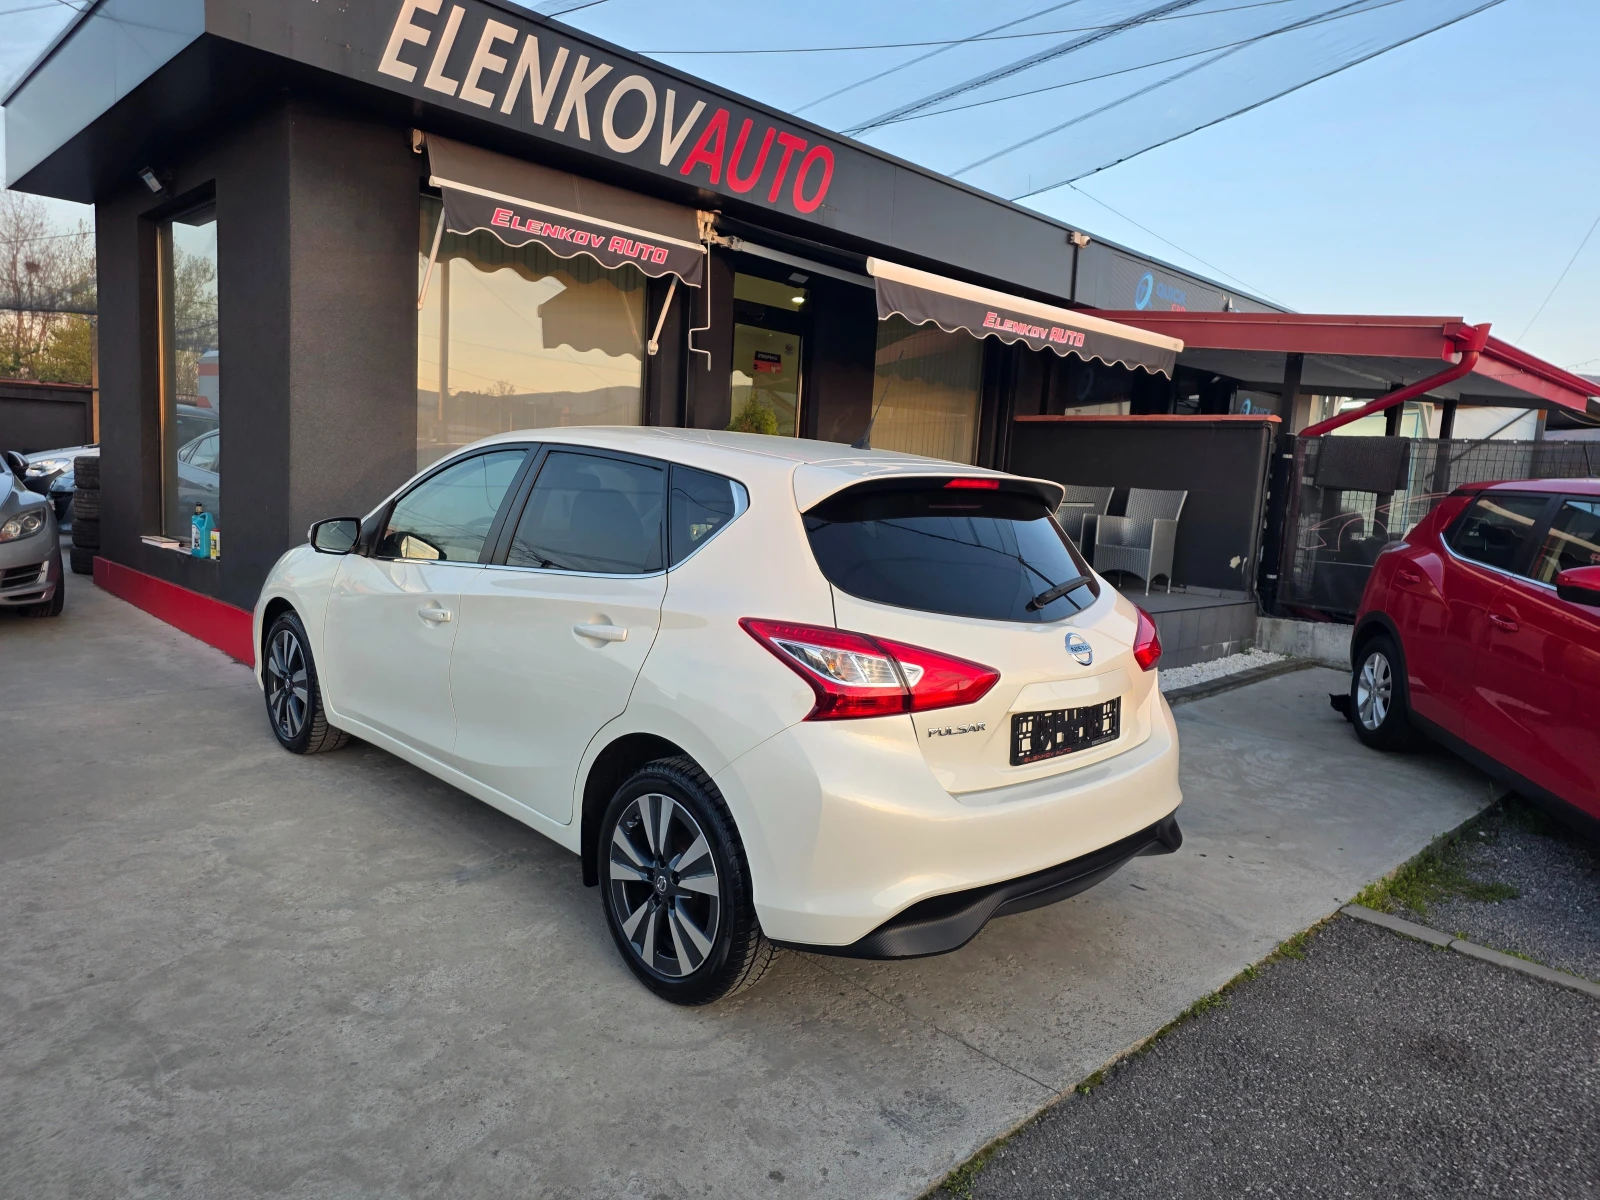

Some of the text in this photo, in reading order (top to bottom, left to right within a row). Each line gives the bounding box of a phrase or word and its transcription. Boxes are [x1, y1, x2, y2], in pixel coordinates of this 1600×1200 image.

[491, 207, 669, 265] ELENKOV AUTO
[1156, 282, 1187, 306] QUICK
[983, 311, 1085, 347] ELENKOV AUTO
[928, 721, 986, 738] PULSAR
[1055, 747, 1072, 756] AUTO
